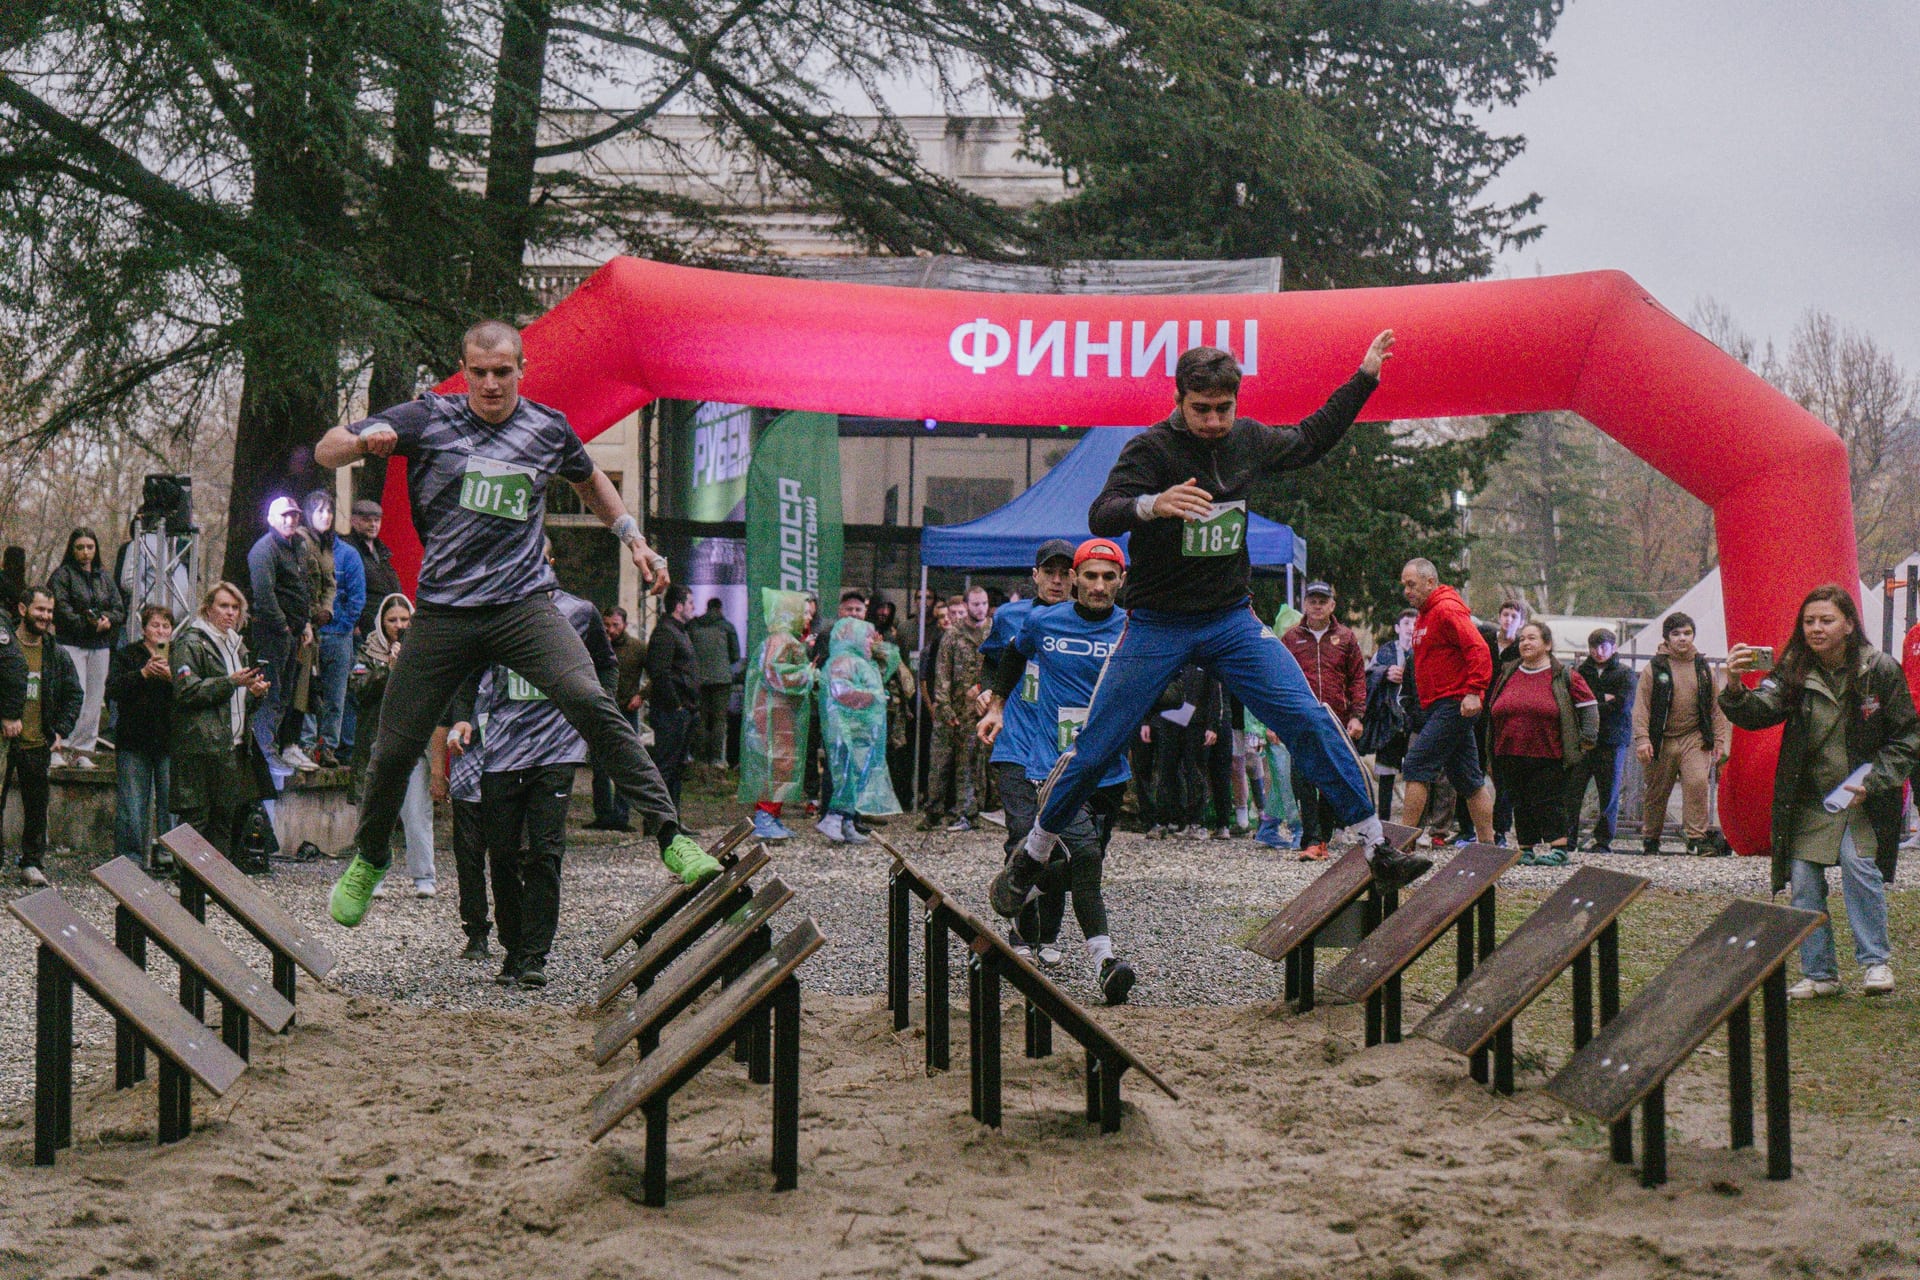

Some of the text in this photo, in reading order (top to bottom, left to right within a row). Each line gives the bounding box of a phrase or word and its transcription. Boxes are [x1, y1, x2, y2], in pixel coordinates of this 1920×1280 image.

[949, 318, 1257, 377] ФИНИШ
[779, 477, 802, 592] ОЛОСА
[1199, 523, 1242, 552] 18-2
